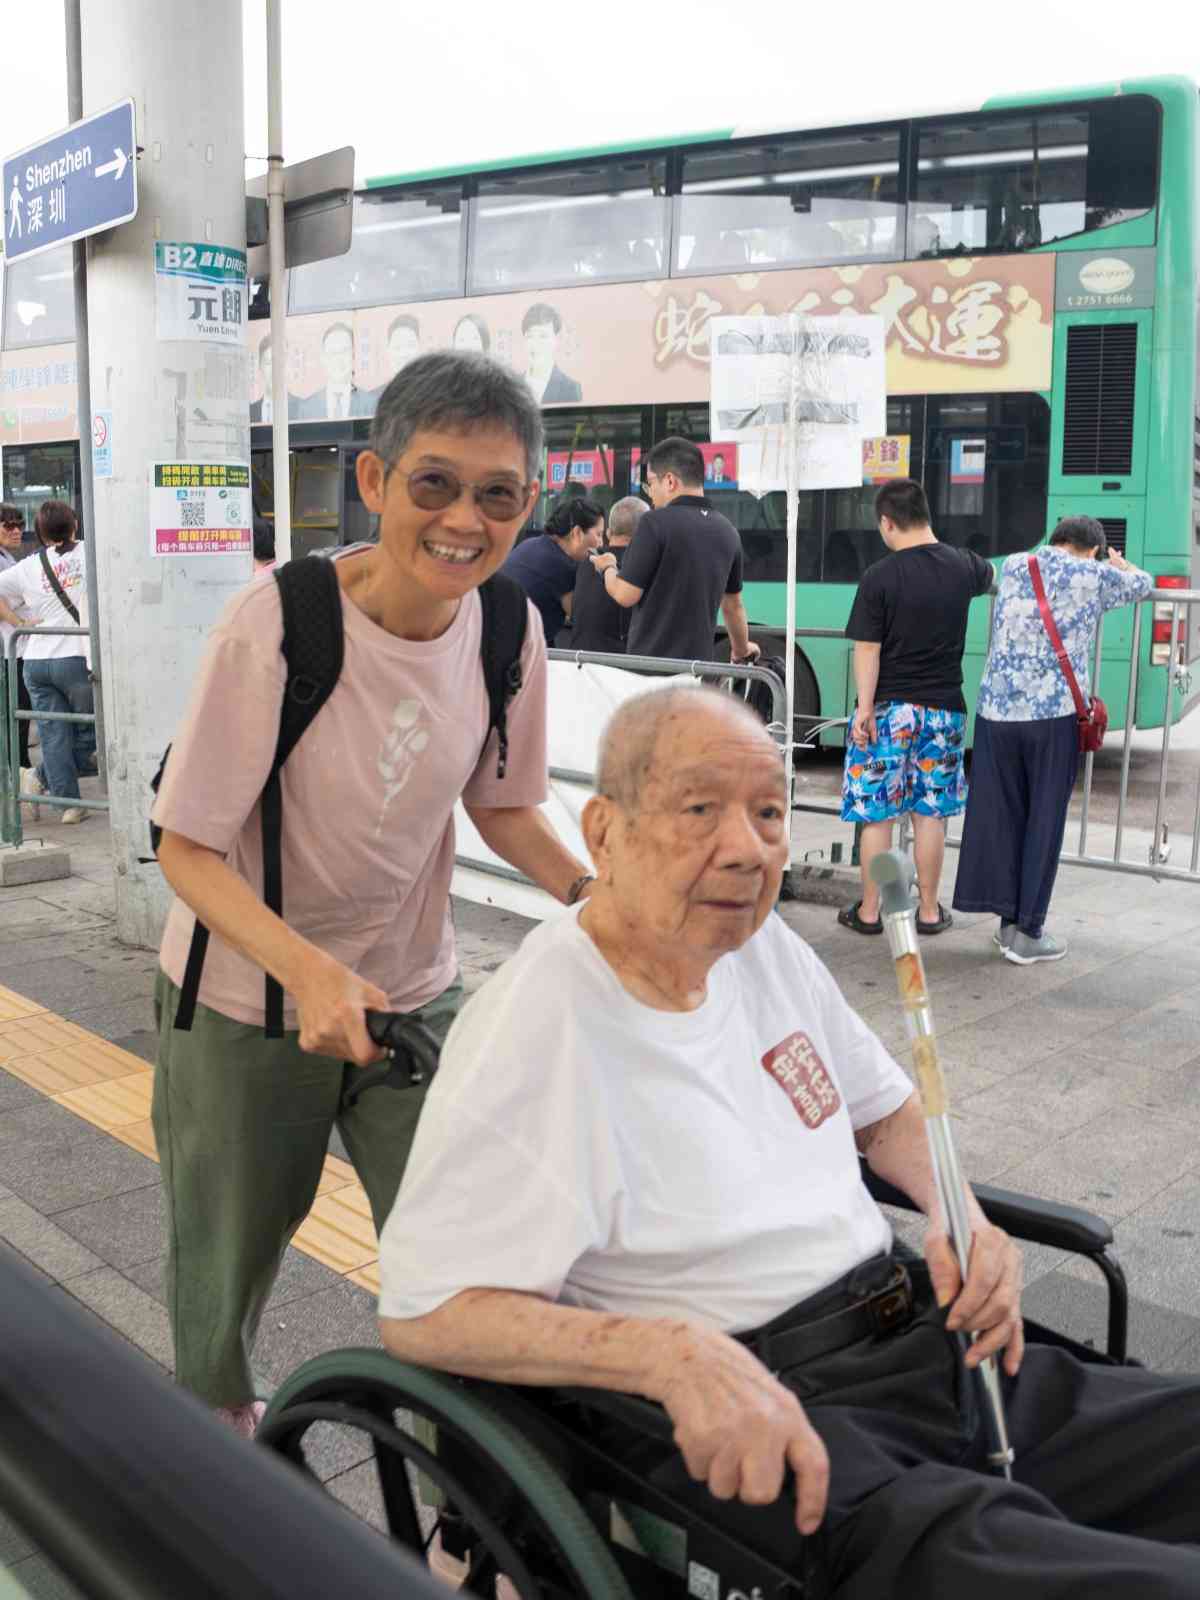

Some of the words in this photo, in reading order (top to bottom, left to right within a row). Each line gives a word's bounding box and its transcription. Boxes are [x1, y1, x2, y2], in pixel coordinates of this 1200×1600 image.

[26, 145, 92, 192] Shenzhen
[27, 184, 66, 234] 深圳
[163, 246, 197, 269] B2
[187, 284, 241, 324] 元朗
[197, 324, 219, 334] Yuen
